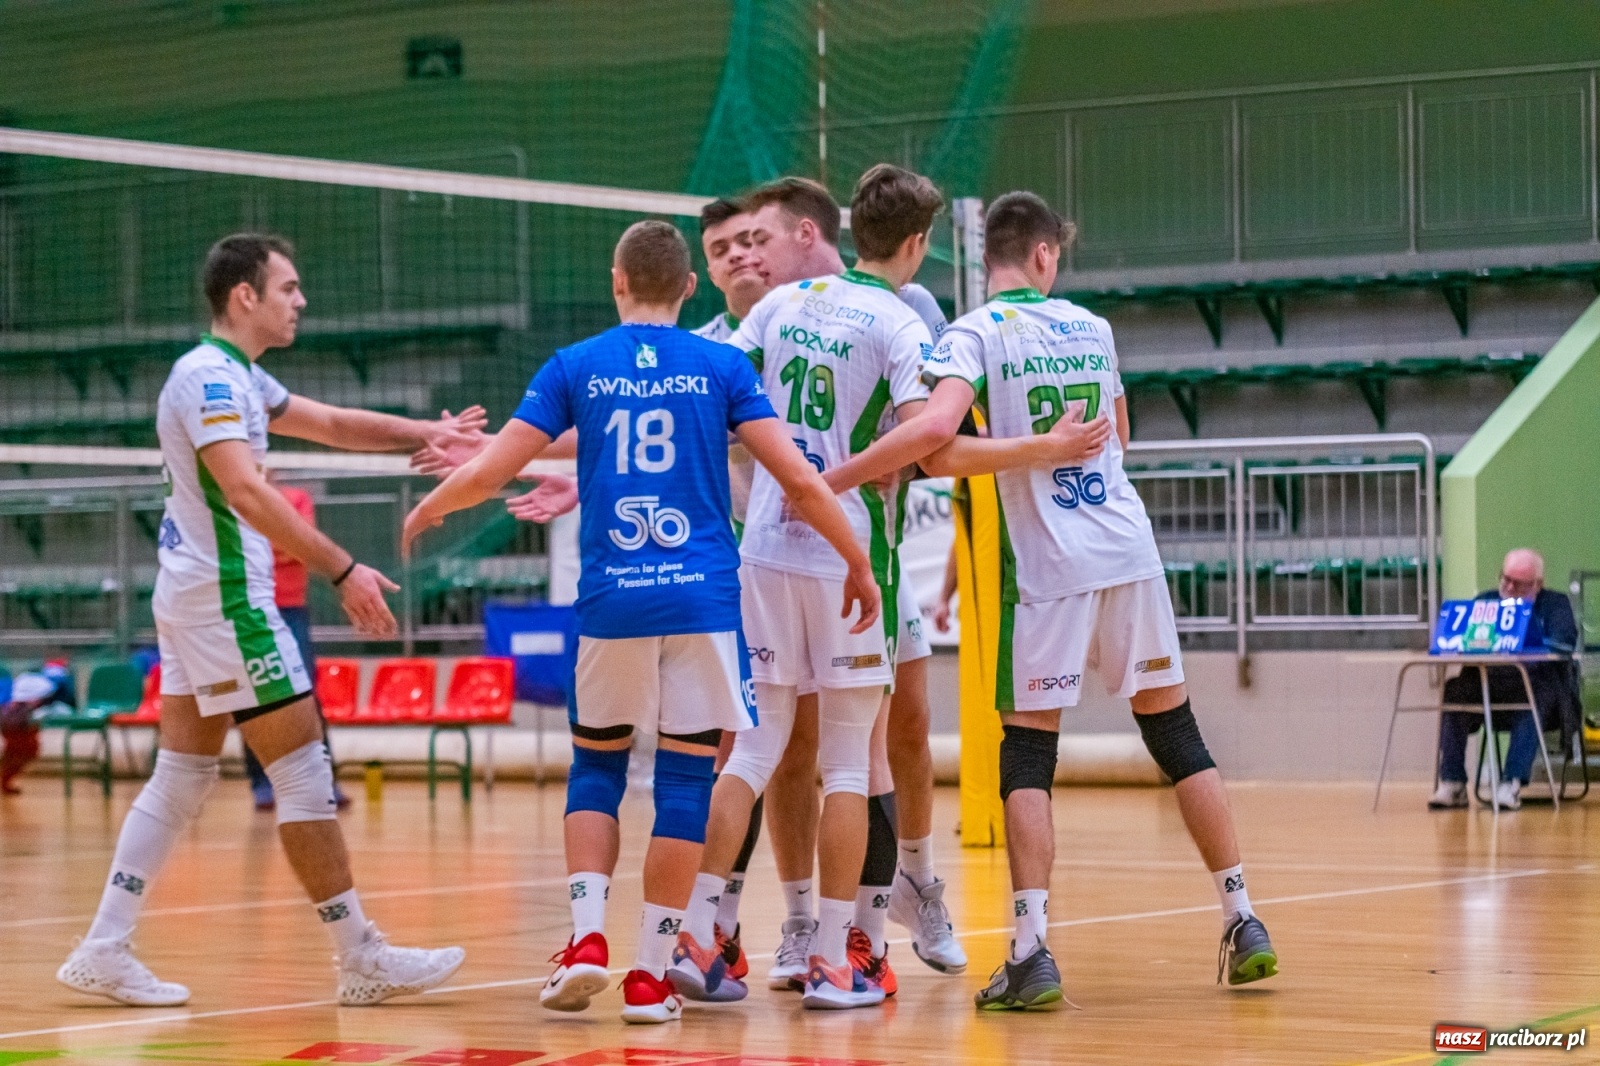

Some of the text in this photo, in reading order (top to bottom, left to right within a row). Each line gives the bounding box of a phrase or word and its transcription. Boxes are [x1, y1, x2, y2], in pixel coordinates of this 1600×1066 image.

[1050, 319, 1098, 337] team
[1001, 353, 1111, 381] PŁATKOWSKI
[587, 374, 709, 399] ŚWINIARSKI
[780, 355, 835, 431] 19
[1027, 382, 1100, 435] 27
[603, 408, 676, 475] 18
[618, 572, 705, 589] Passion for Sports
[642, 563, 655, 574] for
[658, 561, 683, 574] glass
[1451, 605, 1467, 631] 7
[1500, 606, 1516, 631] 6
[246, 651, 288, 687] 25
[1028, 674, 1081, 692] BTSPORT
